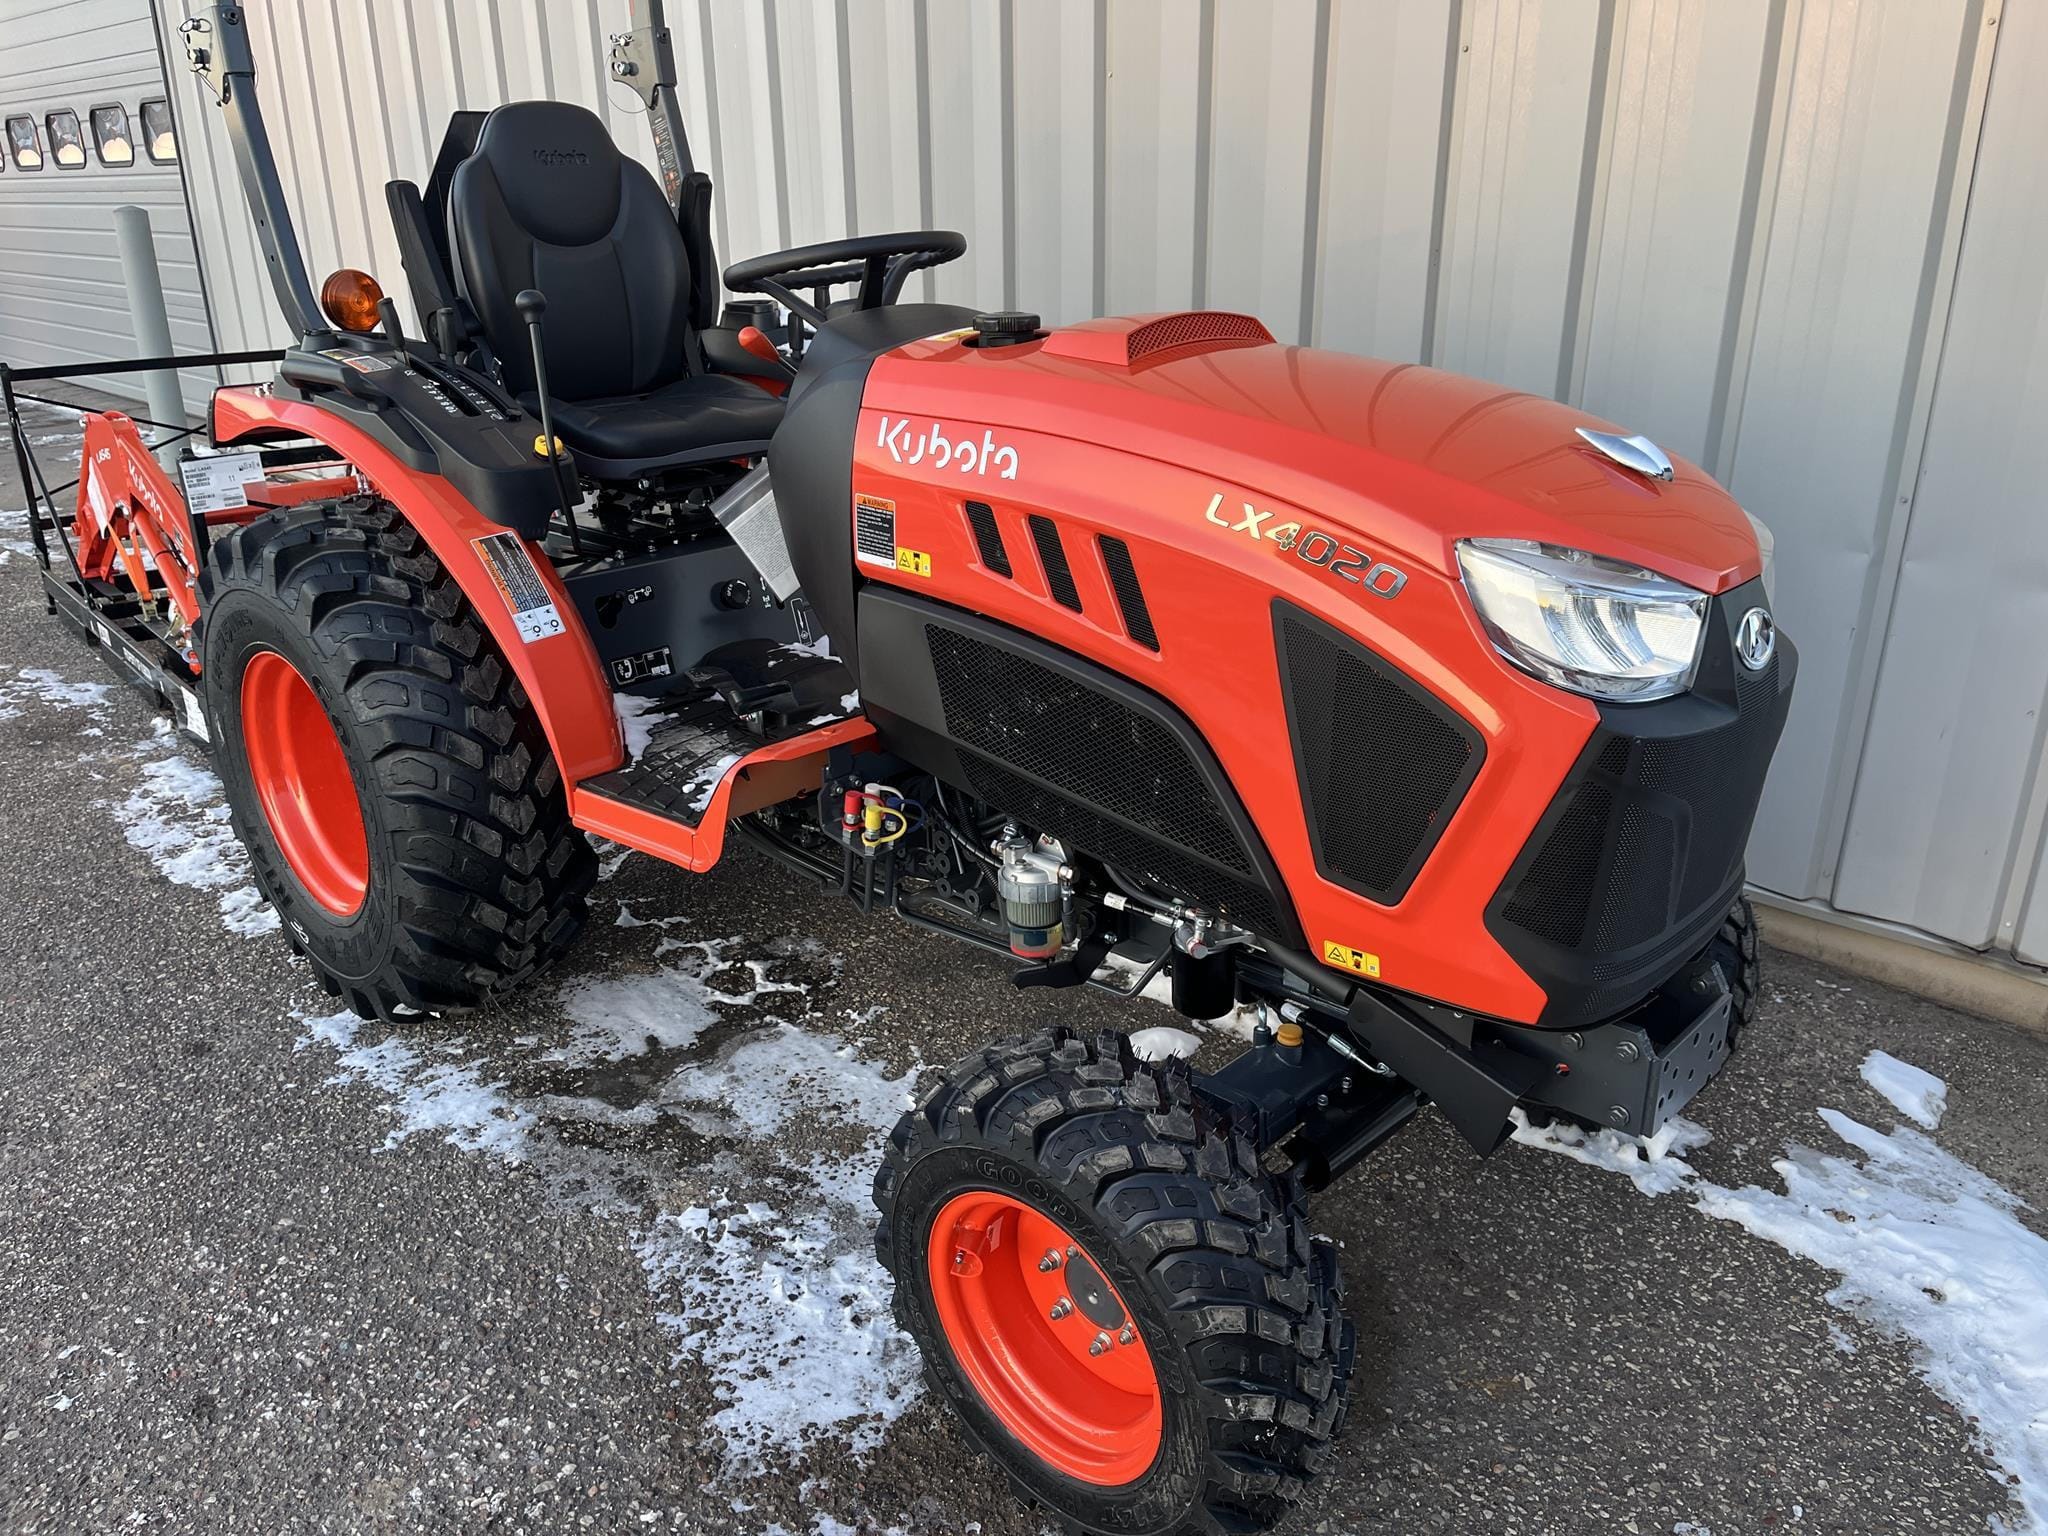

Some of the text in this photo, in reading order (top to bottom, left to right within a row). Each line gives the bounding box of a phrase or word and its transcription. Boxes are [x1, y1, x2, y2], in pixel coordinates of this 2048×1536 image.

[533, 149, 591, 166] Kubota
[877, 416, 1020, 480] Kubota
[128, 458, 164, 523] Kubota
[1204, 493, 1409, 600] LX4020
[976, 1156, 1186, 1395] GOODYEAR
